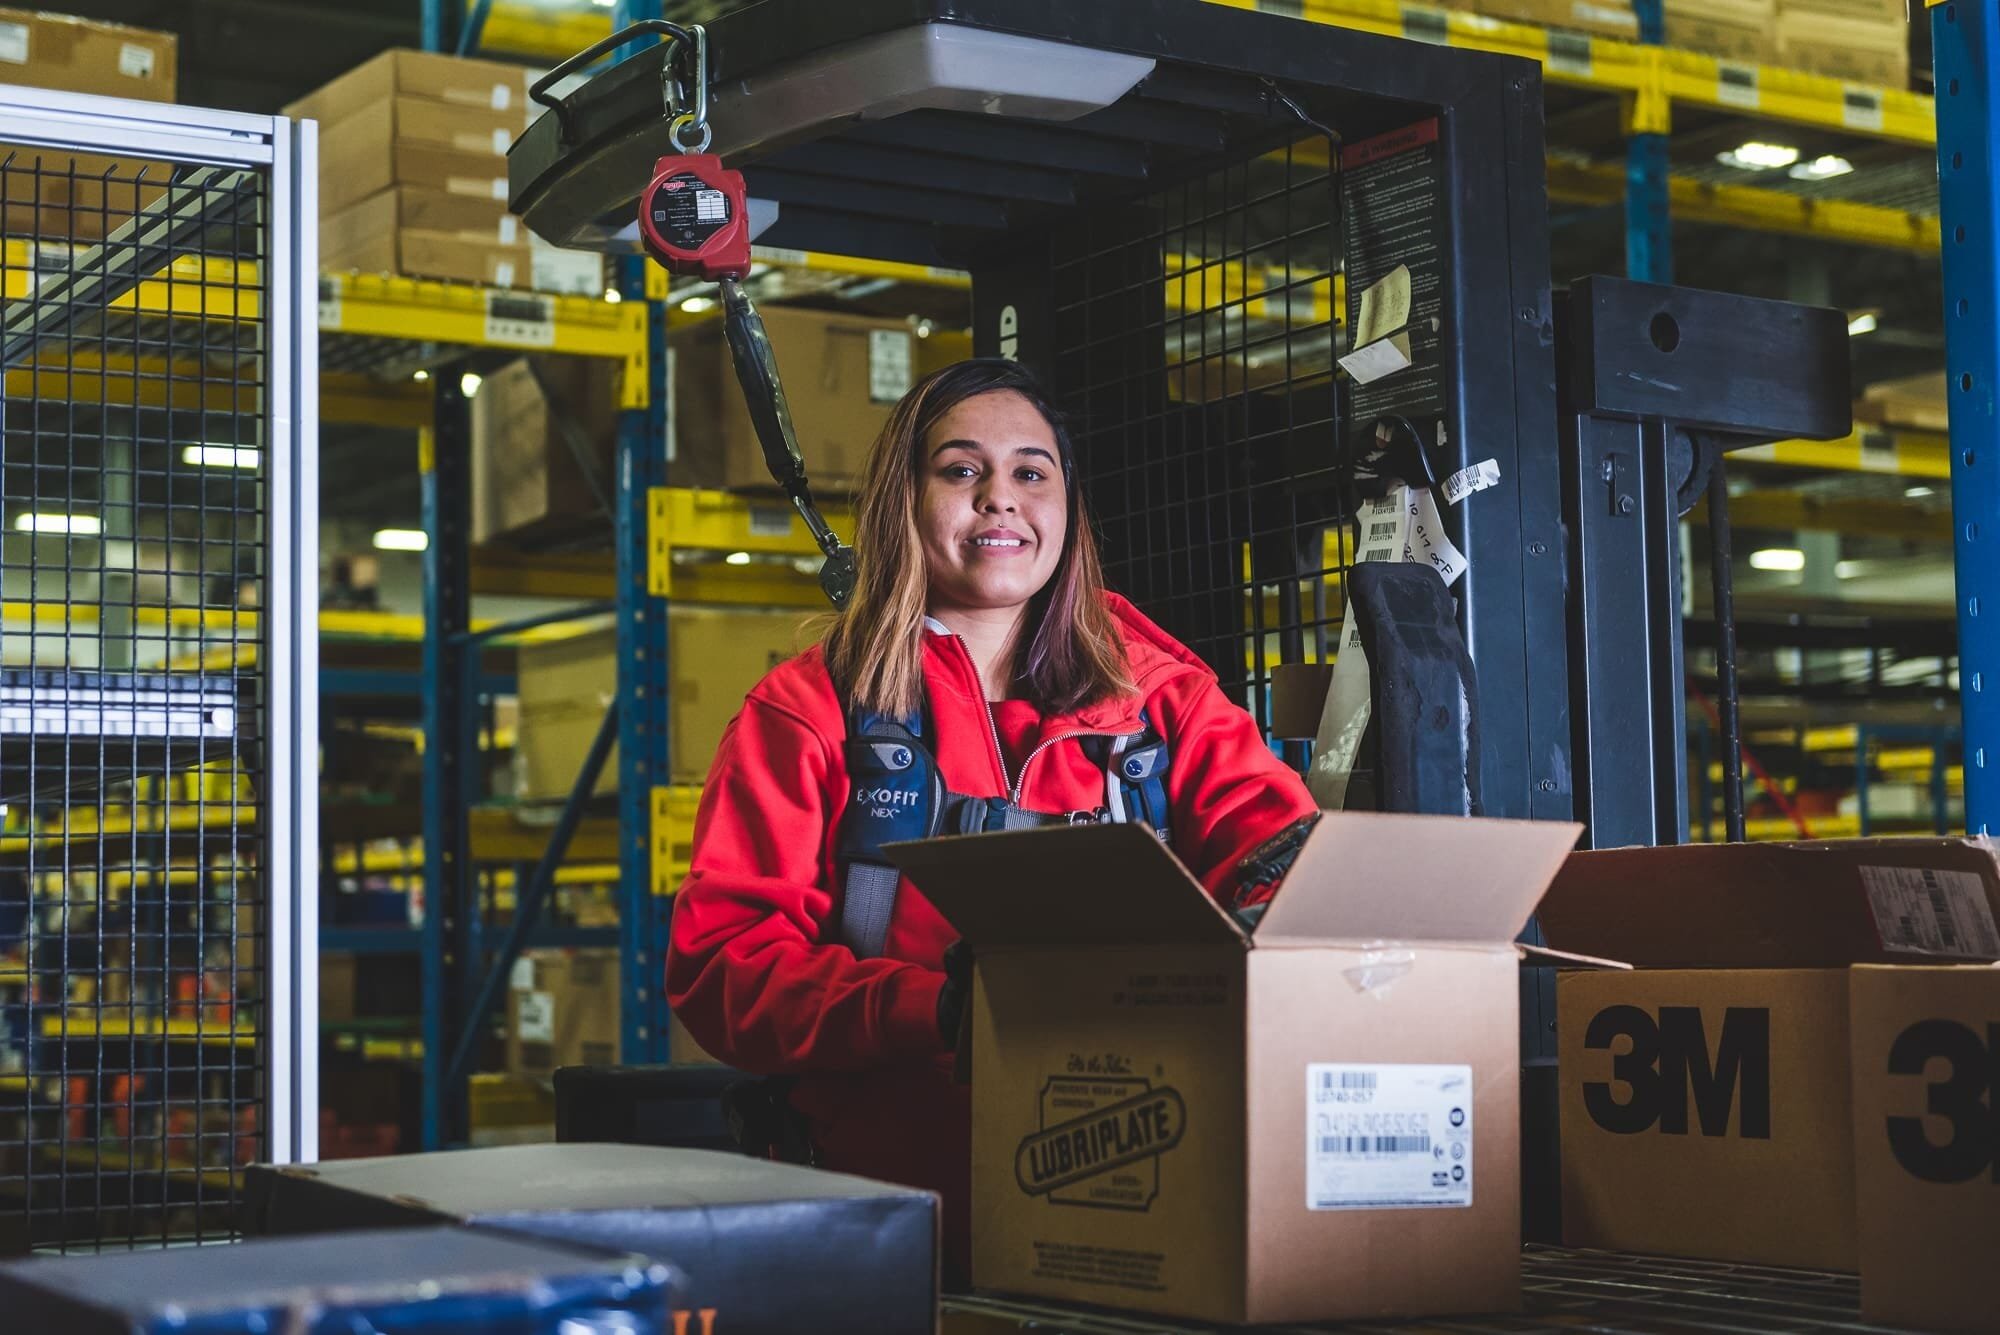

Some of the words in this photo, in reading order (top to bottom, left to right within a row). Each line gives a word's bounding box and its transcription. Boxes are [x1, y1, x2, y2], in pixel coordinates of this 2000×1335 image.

[857, 787, 919, 806] EXOFIT
[1582, 1004, 1771, 1140] 3M
[1886, 1018, 2000, 1186] 3
[1029, 1100, 1171, 1184] LUBRIPLATE
